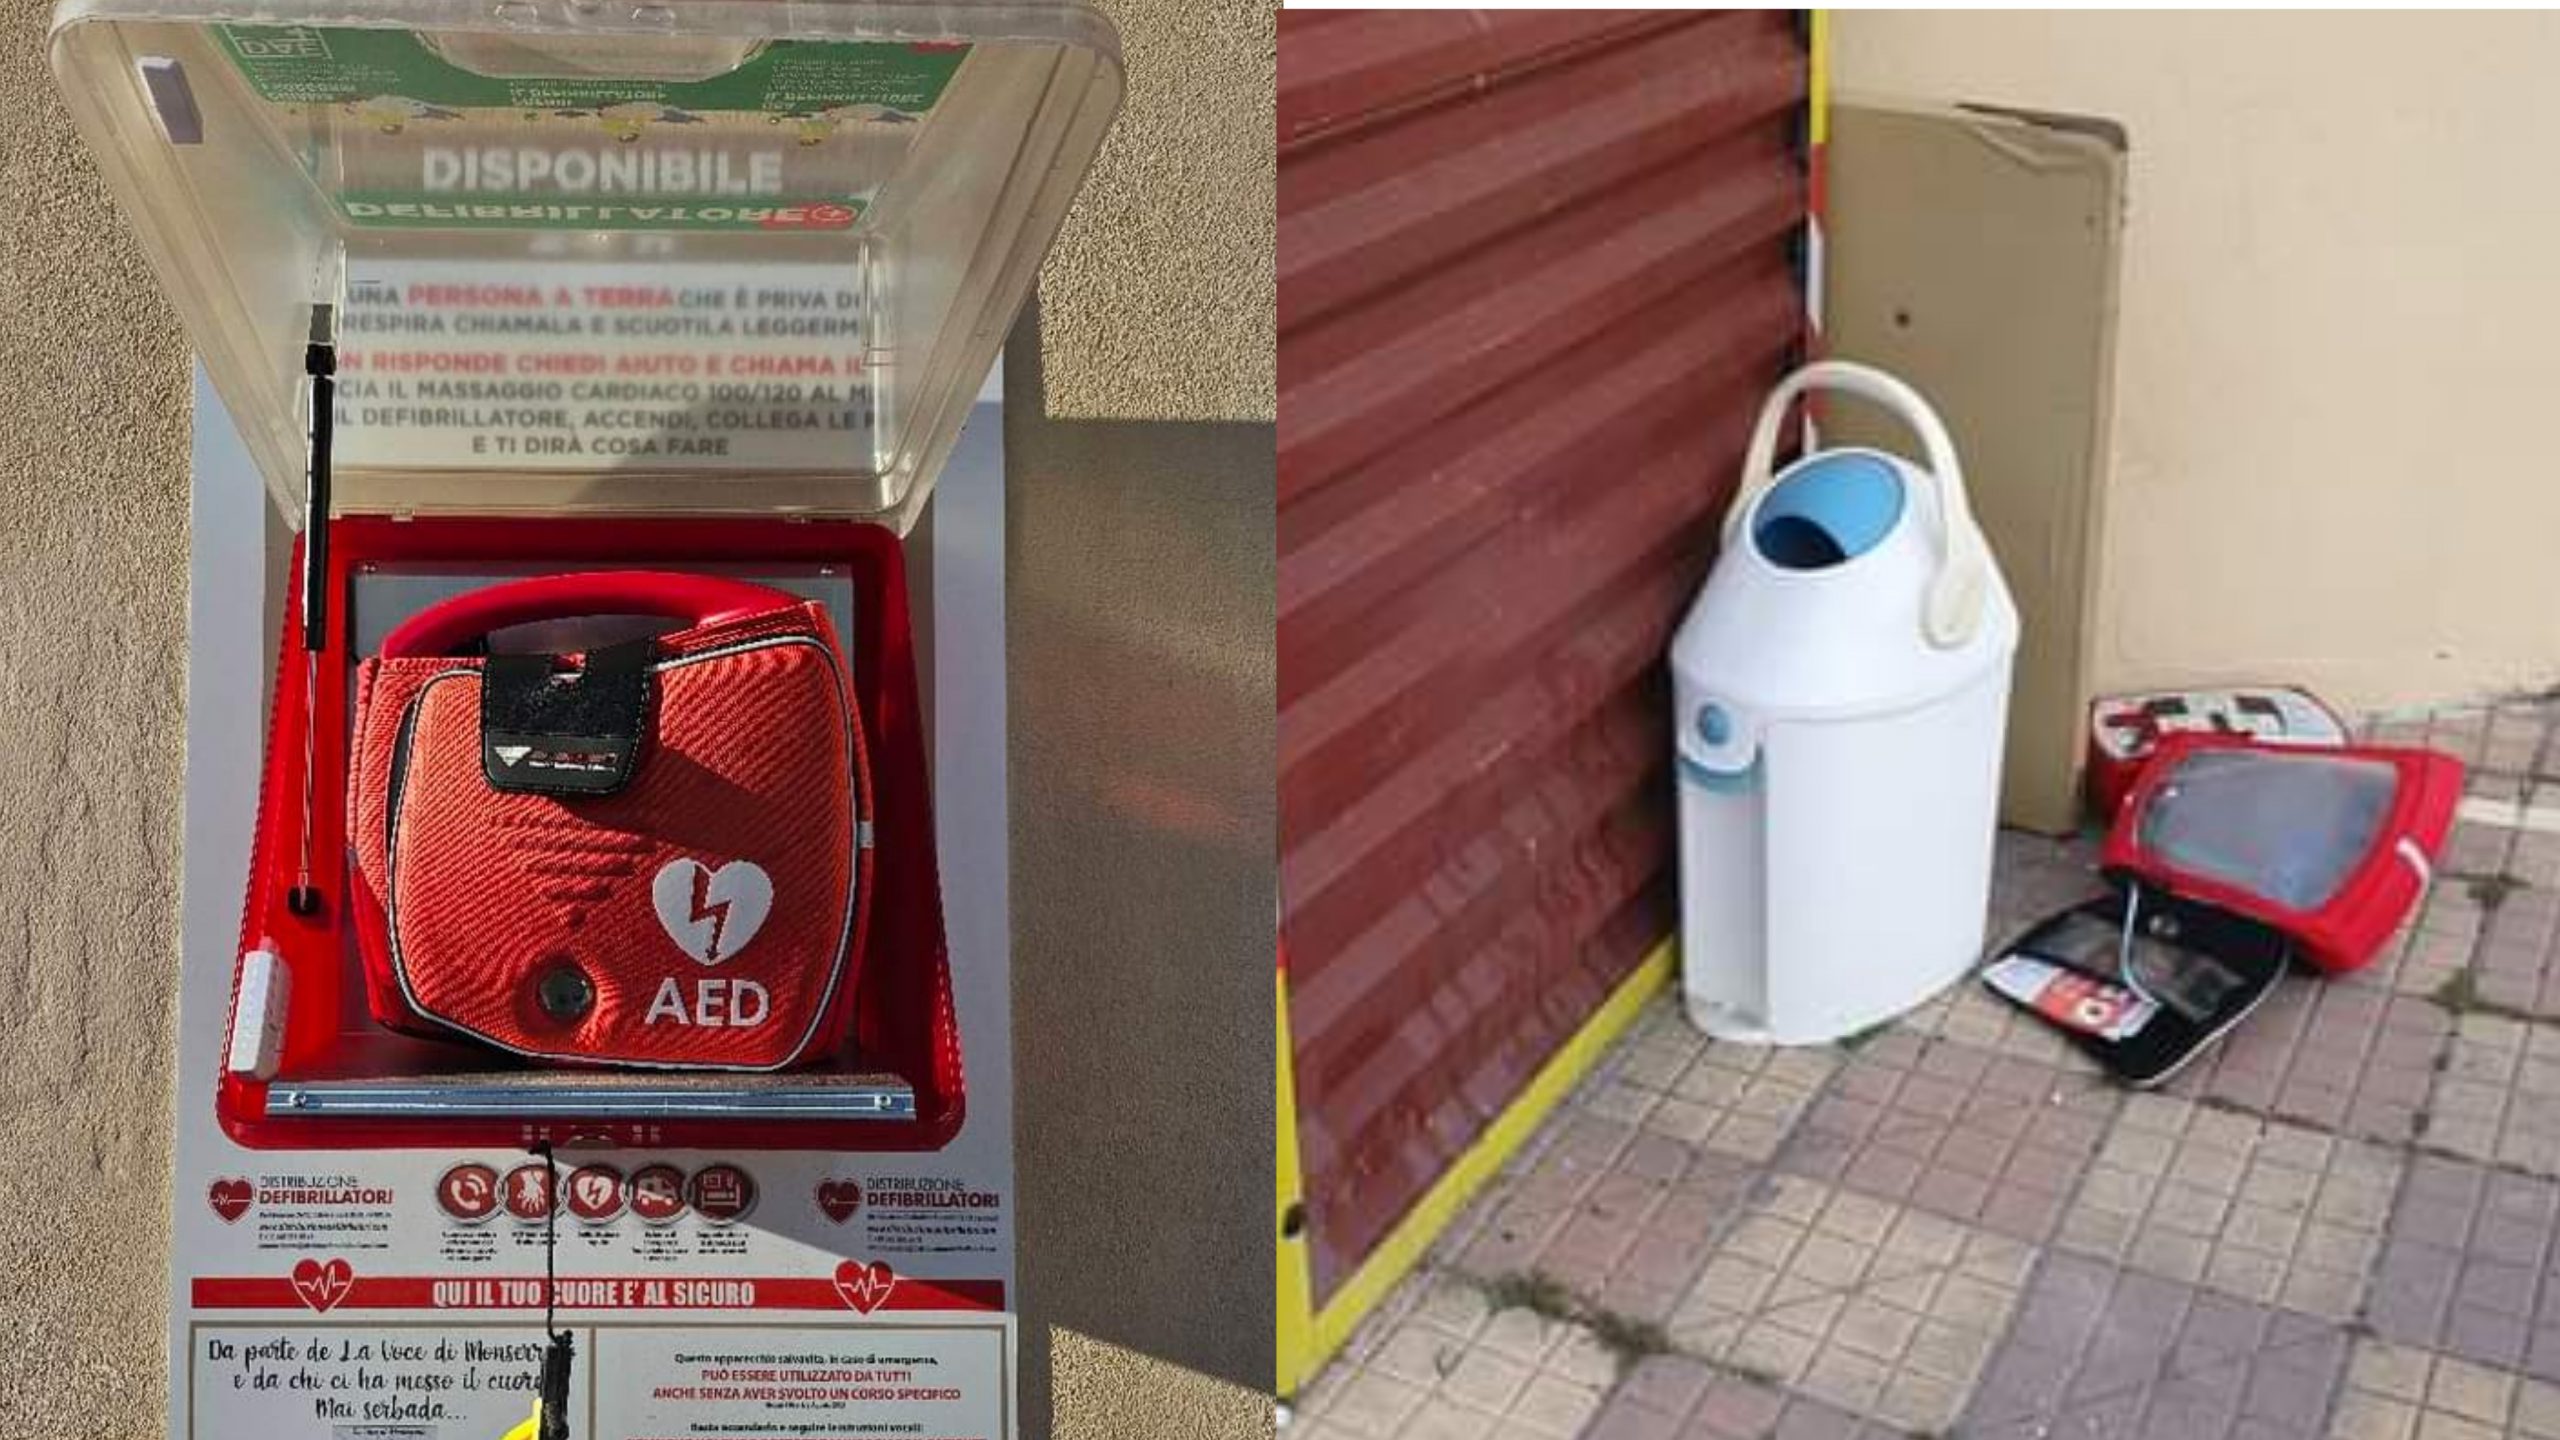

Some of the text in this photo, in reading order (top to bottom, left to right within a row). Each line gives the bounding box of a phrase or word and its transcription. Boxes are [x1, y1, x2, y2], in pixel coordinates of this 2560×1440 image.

[422, 148, 783, 192] DISPONIBILE
[349, 288, 399, 305] UNA
[407, 285, 544, 307] PERSONA
[554, 288, 572, 307] A
[583, 287, 674, 308] TERRA
[679, 290, 724, 308] CHE
[757, 291, 828, 309] PRIVA
[836, 291, 860, 309] DI
[343, 314, 859, 336] RESPIRA CHIAMALA E SCUOTILA LEGGERM
[372, 353, 507, 373] RISPONDE
[516, 354, 606, 373] CHIEDI
[616, 355, 698, 374] AIUTO
[706, 356, 721, 374] E
[730, 356, 834, 375] CHIAMA
[337, 379, 875, 404] CIA IL MASSAGGIO CARDIACO 100/120 AL MI
[362, 407, 575, 430] DEFIBRILLATORE,
[583, 410, 698, 431] ACCENDI,
[707, 411, 820, 430] COLLEGA
[828, 411, 856, 429] LE
[473, 428, 729, 455] E TI DIRÀ COSA FARE
[645, 978, 770, 1027] AED
[260, 1176, 358, 1188] DISTRIBUZIONE
[867, 1177, 965, 1191] DISTRIBUZIONE
[259, 1189, 393, 1204] DEFIBRILLATORI
[867, 1192, 998, 1207] DEFIBRILLATORI
[433, 1281, 470, 1307] QUI
[476, 1281, 494, 1305] IL
[499, 1281, 541, 1306] TUO
[547, 1281, 617, 1306] CUORE
[643, 1281, 667, 1305] AL
[673, 1281, 755, 1306] SICURO
[208, 1340, 236, 1360] Da
[244, 1336, 298, 1372] parte
[306, 1337, 331, 1361] de
[434, 1337, 457, 1361] di
[464, 1340, 575, 1362] Monserr
[234, 1374, 245, 1389] e
[254, 1366, 279, 1390] da
[289, 1366, 322, 1389] chi
[330, 1373, 351, 1389] ci
[358, 1366, 386, 1390] ha
[395, 1373, 454, 1391] messo
[463, 1366, 480, 1390] il
[702, 1369, 911, 1383] PUÒ ESSERE UTILIZZATO DA TUTTI
[654, 1388, 961, 1400] ANCHE SENZA AVER SVOLTO UN CORSO SPECIFICO
[316, 1398, 355, 1419] Mai
